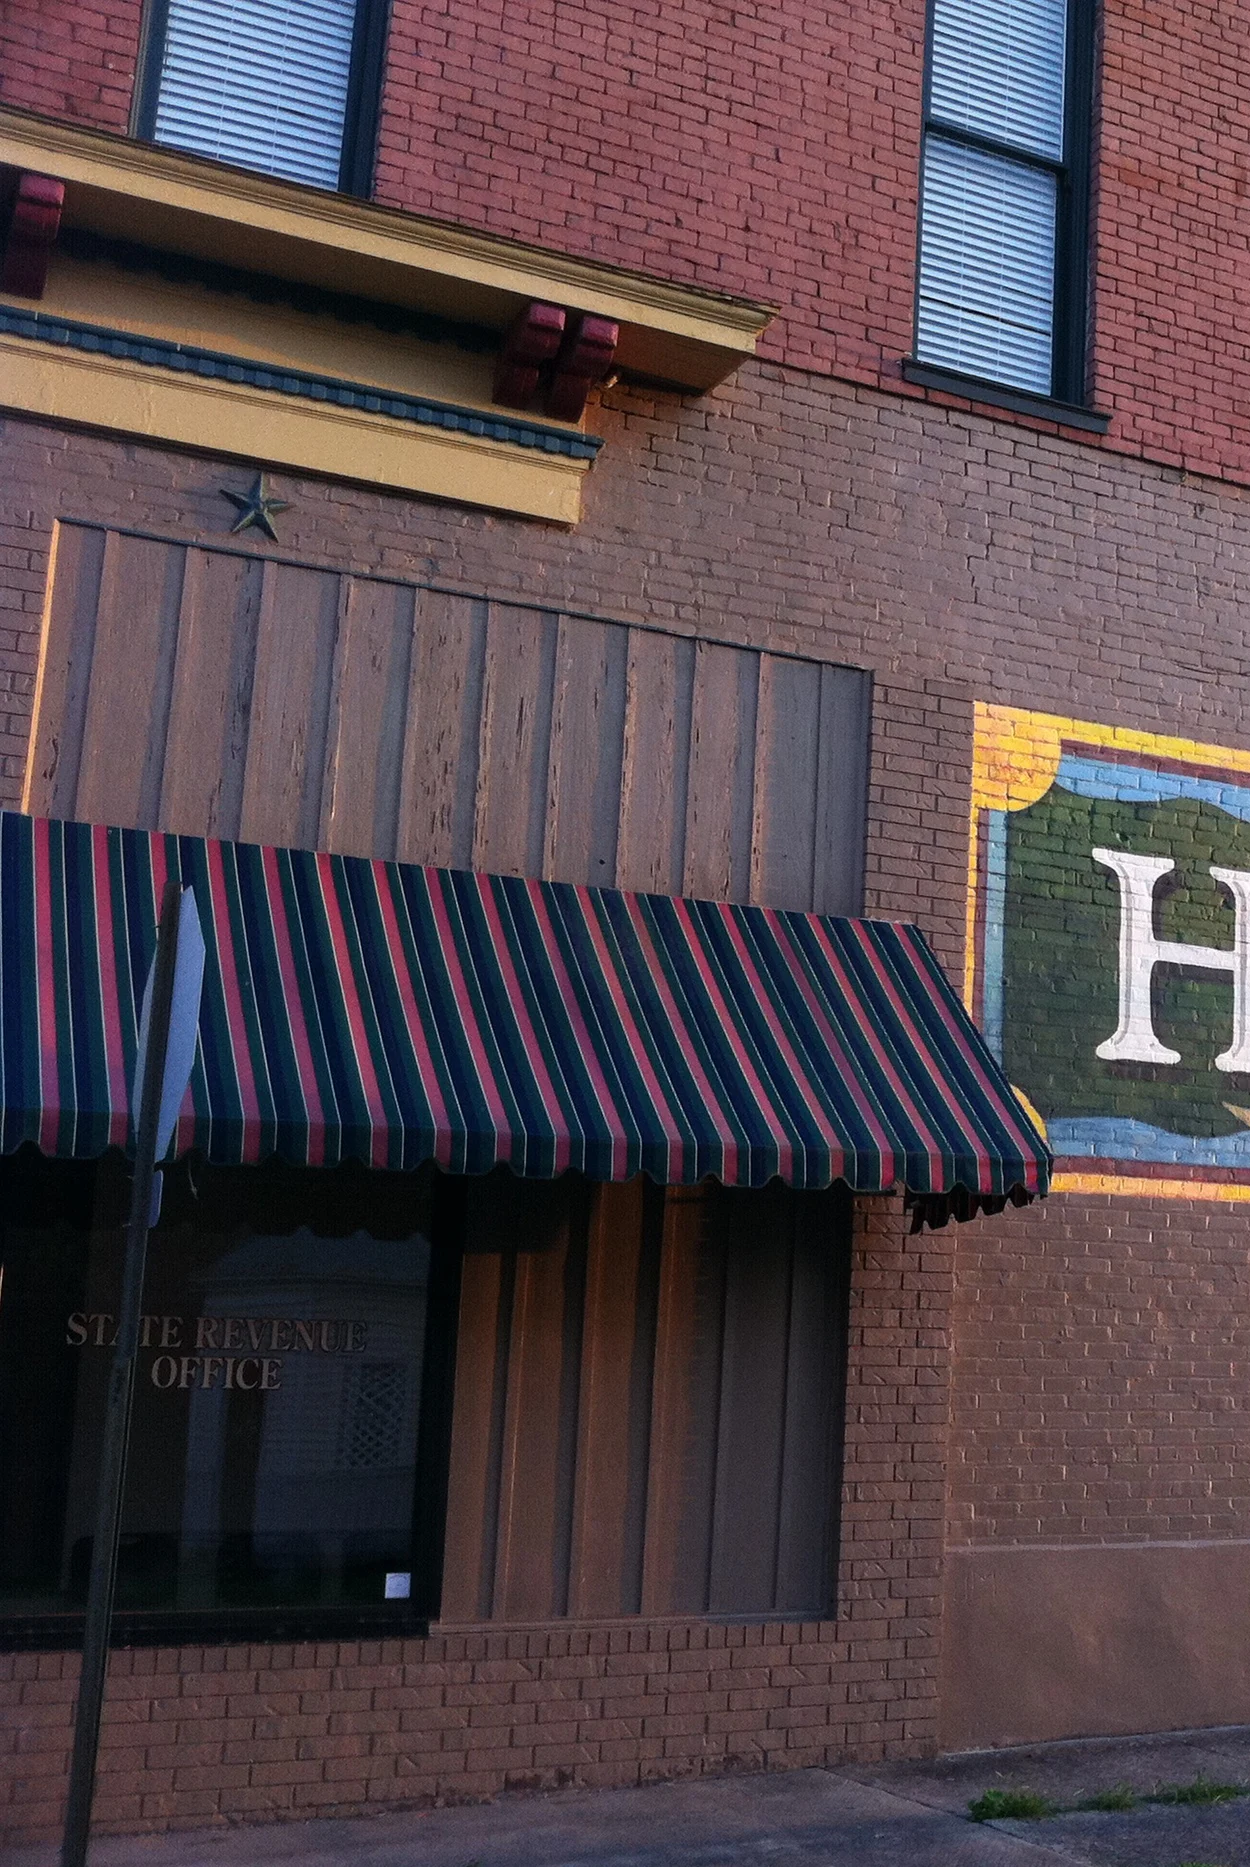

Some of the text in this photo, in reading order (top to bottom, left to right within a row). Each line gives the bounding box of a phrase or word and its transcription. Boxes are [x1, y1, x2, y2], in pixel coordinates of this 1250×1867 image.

[66, 1313, 367, 1352] STTE REVENUE
[151, 1356, 283, 1390] OFFICE
